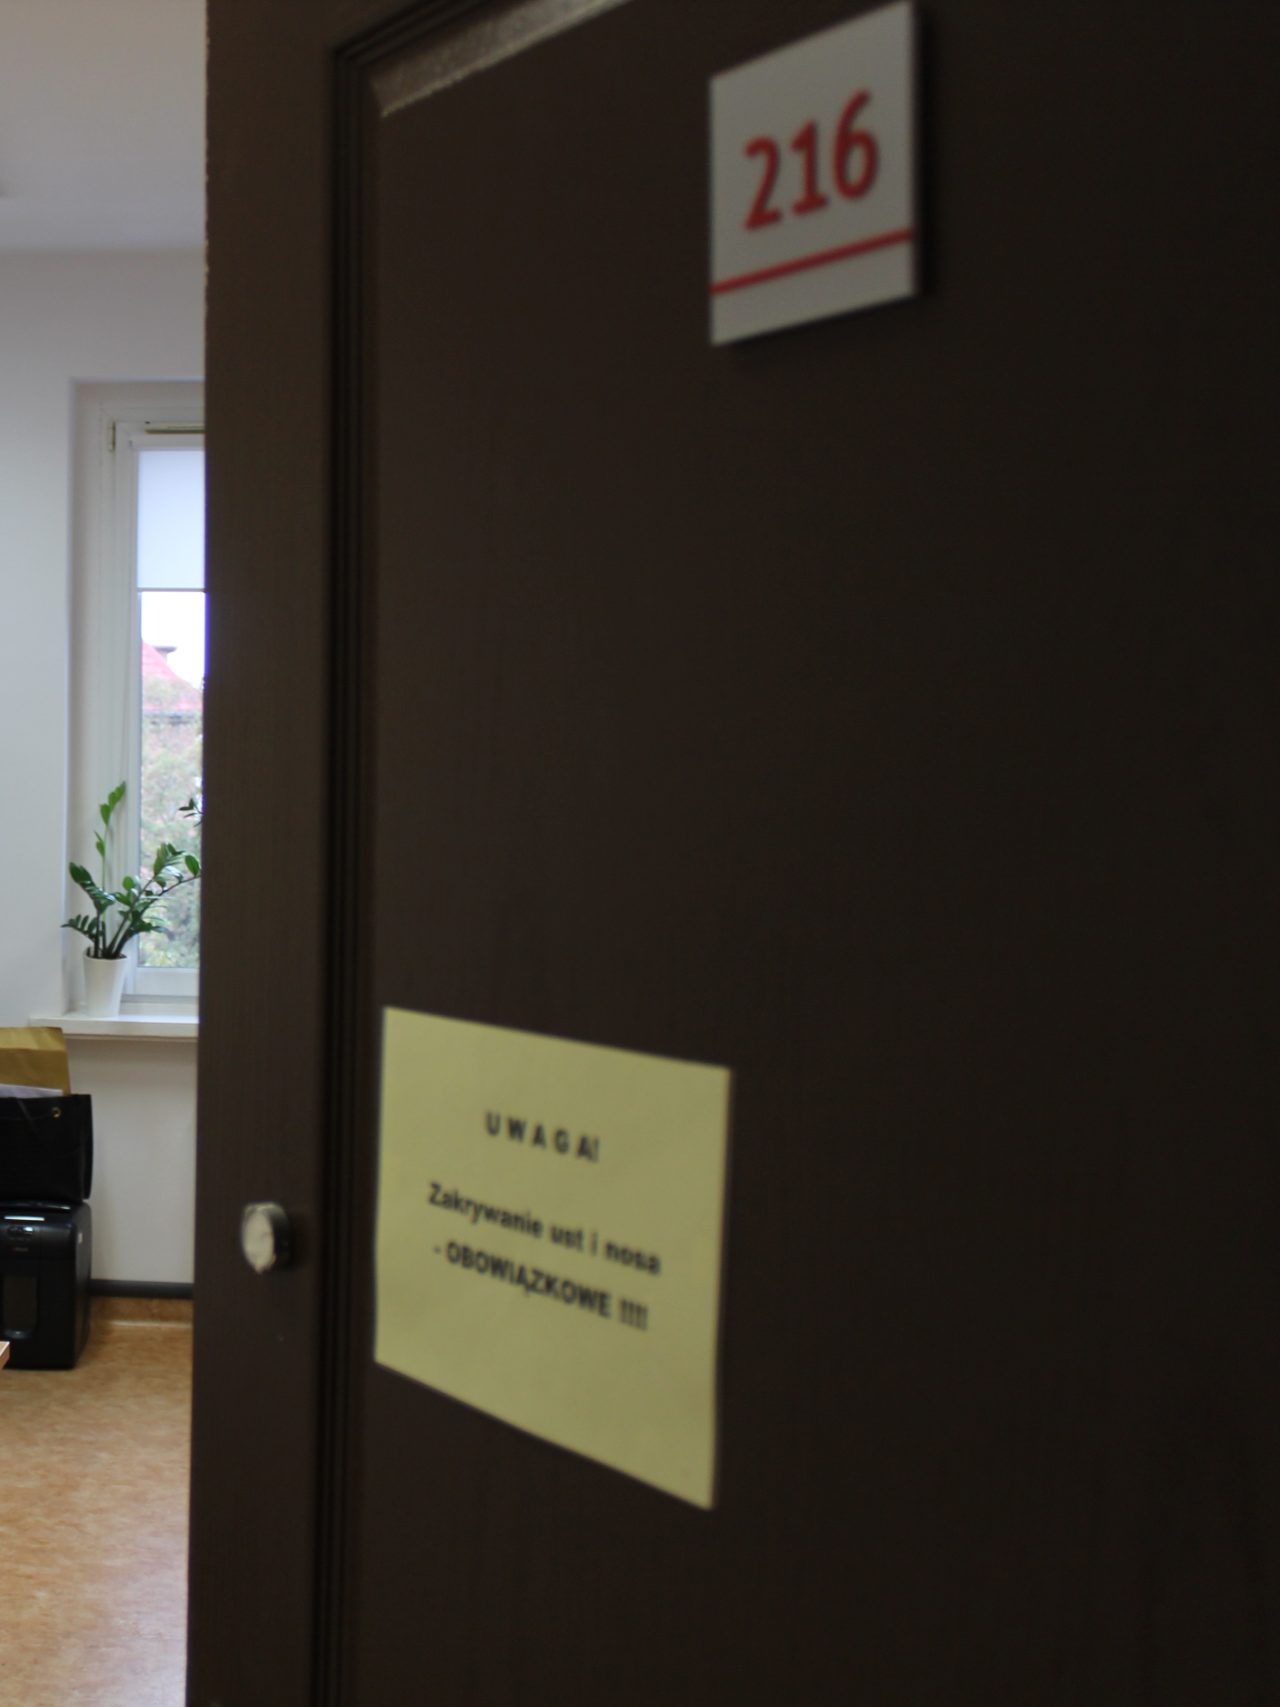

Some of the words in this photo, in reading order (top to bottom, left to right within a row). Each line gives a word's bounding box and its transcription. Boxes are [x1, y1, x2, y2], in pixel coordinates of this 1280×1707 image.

[744, 88, 880, 231] 216
[428, 1181, 544, 1239] Zakrywanie
[549, 1224, 585, 1254] ust
[590, 1230, 599, 1257] i
[605, 1241, 662, 1276] nosa
[447, 1241, 612, 1318] OBOWIĄZKOWE
